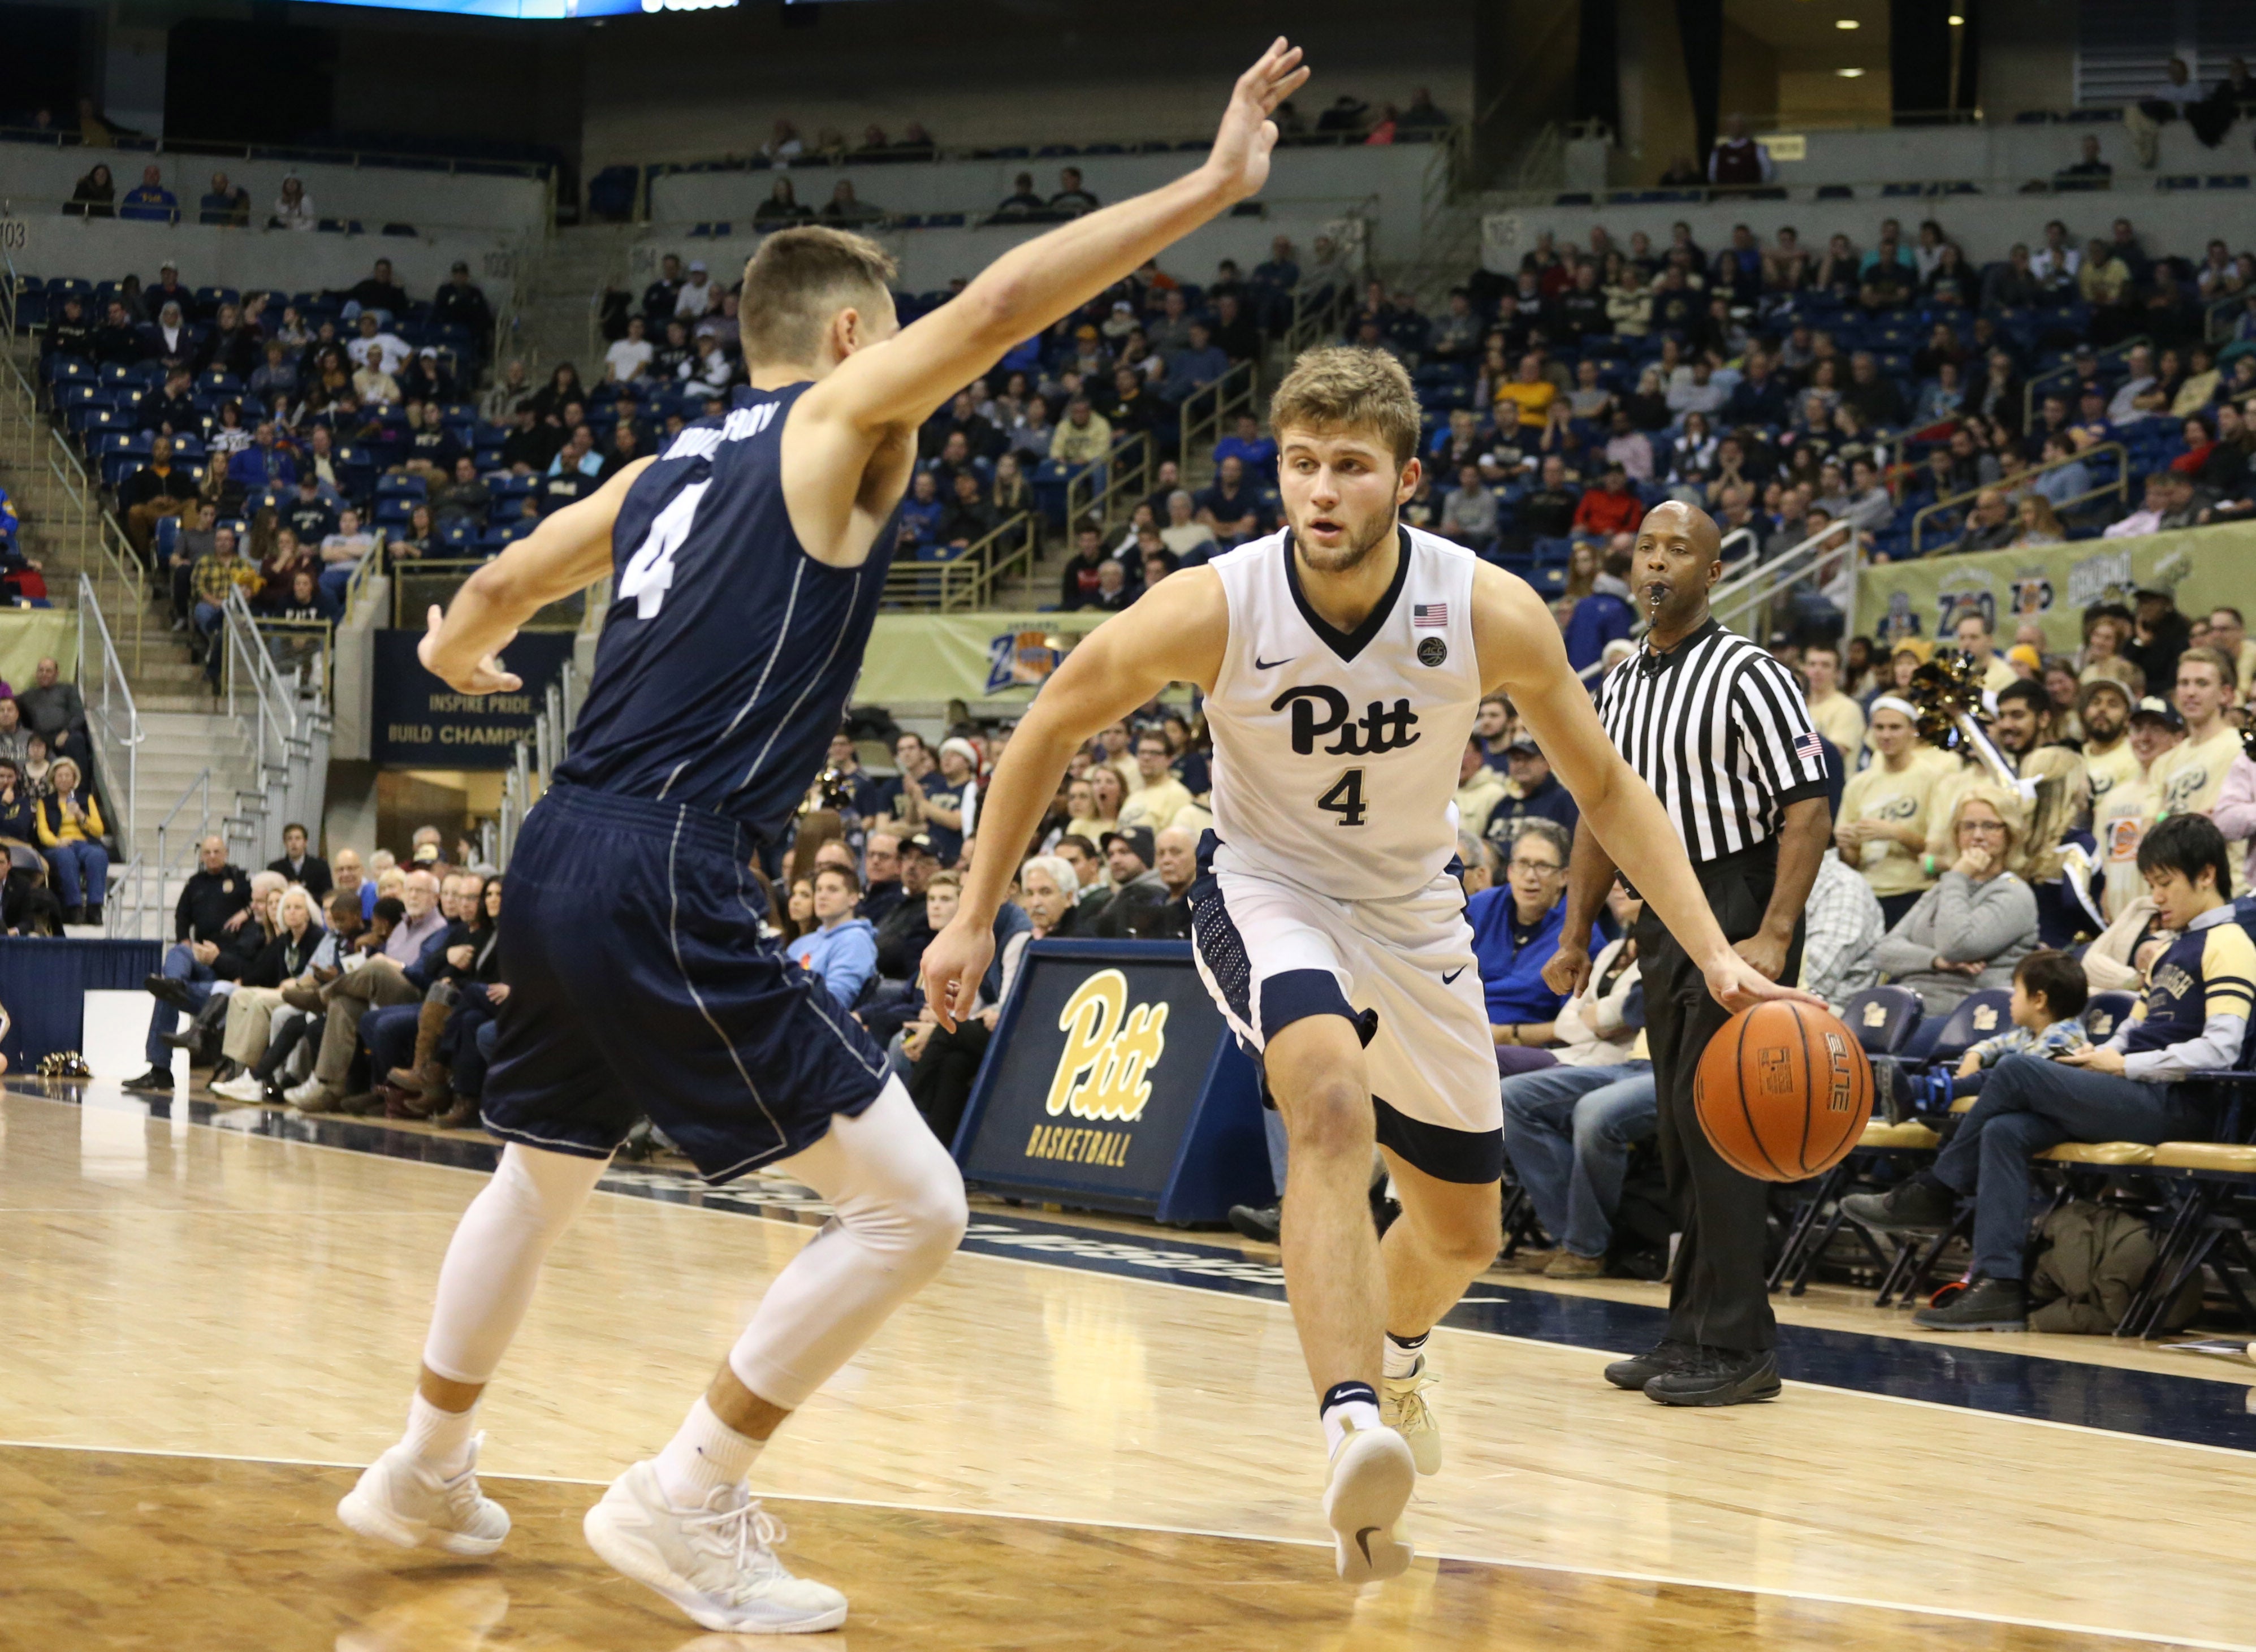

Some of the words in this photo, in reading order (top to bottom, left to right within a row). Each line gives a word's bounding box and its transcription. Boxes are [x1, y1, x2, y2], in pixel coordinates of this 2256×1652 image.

[618, 477, 714, 620] 4
[388, 724, 434, 744] BUILD
[429, 693, 485, 715] INSPIRE
[489, 695, 532, 715] PRIDE
[1270, 685, 1421, 756] Pitt
[1315, 765, 1369, 828] 4
[1045, 968, 1170, 1123] Pitt
[1825, 1031, 1852, 1113] ELITE
[1025, 1123, 1133, 1169] BASKETBALL
